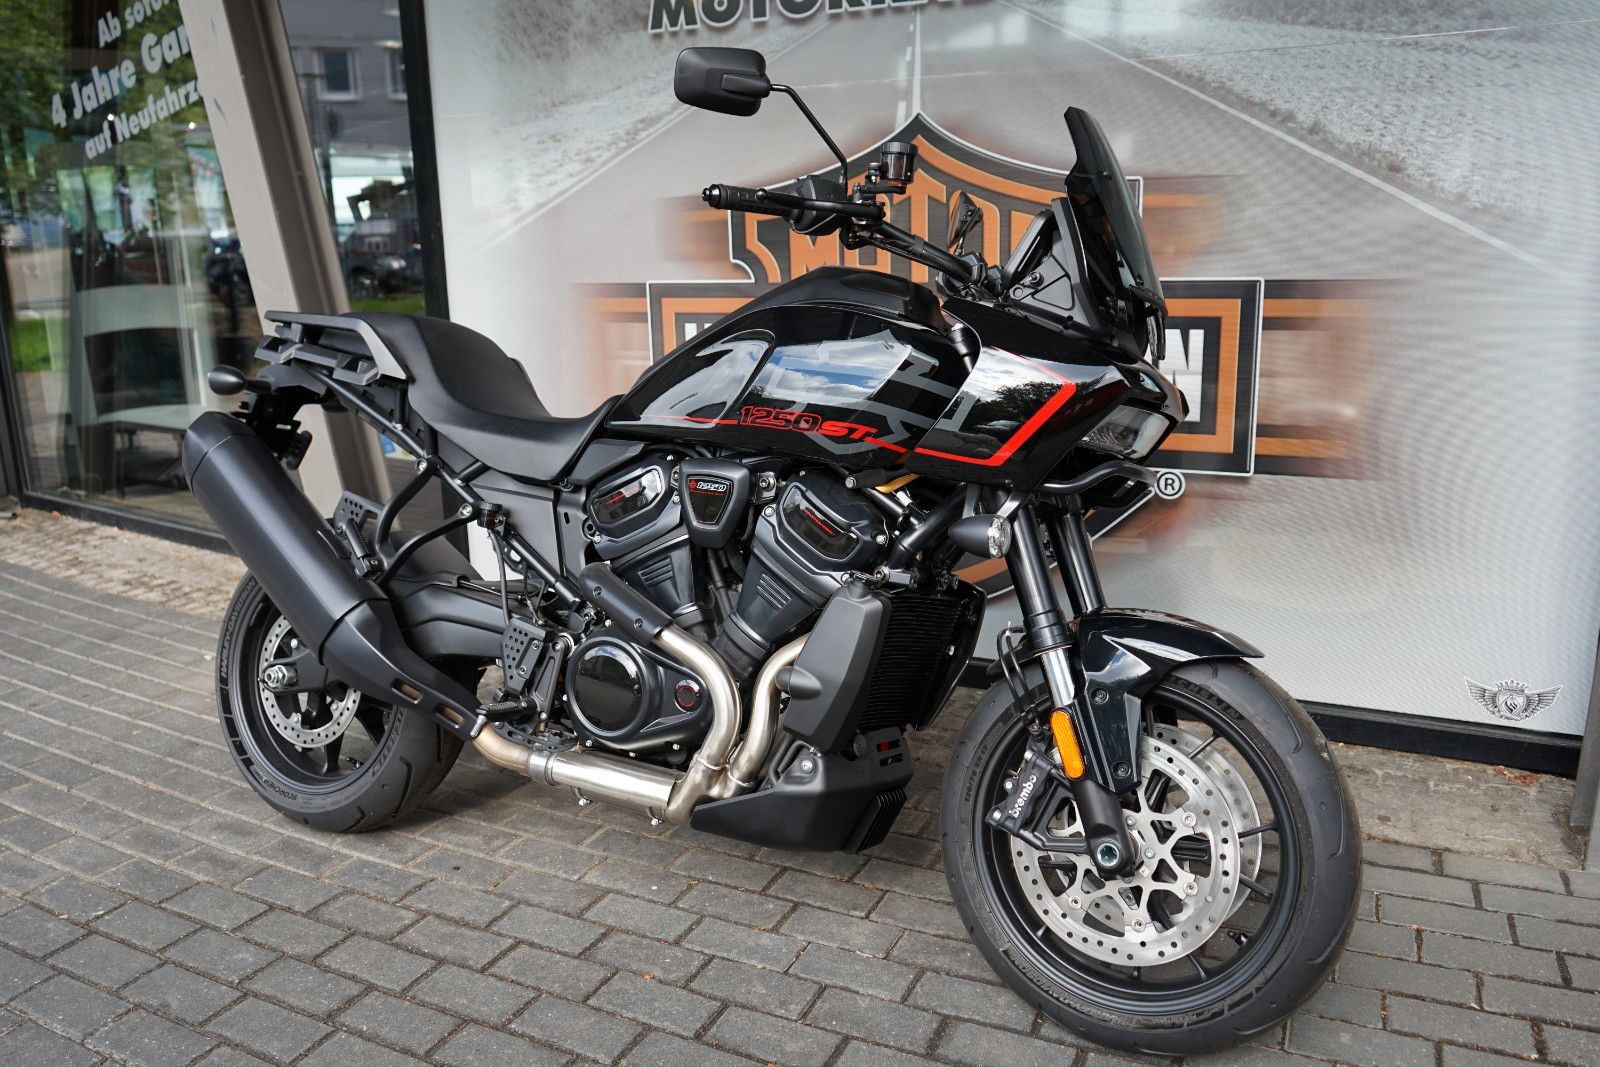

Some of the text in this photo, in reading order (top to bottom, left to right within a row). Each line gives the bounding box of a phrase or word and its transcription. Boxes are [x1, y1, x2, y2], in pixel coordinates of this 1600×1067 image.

[98, 11, 121, 48] Ab
[51, 92, 67, 129] 4
[70, 58, 136, 120] Jahre
[84, 119, 112, 160] auf
[1009, 774, 1037, 818] brembo
